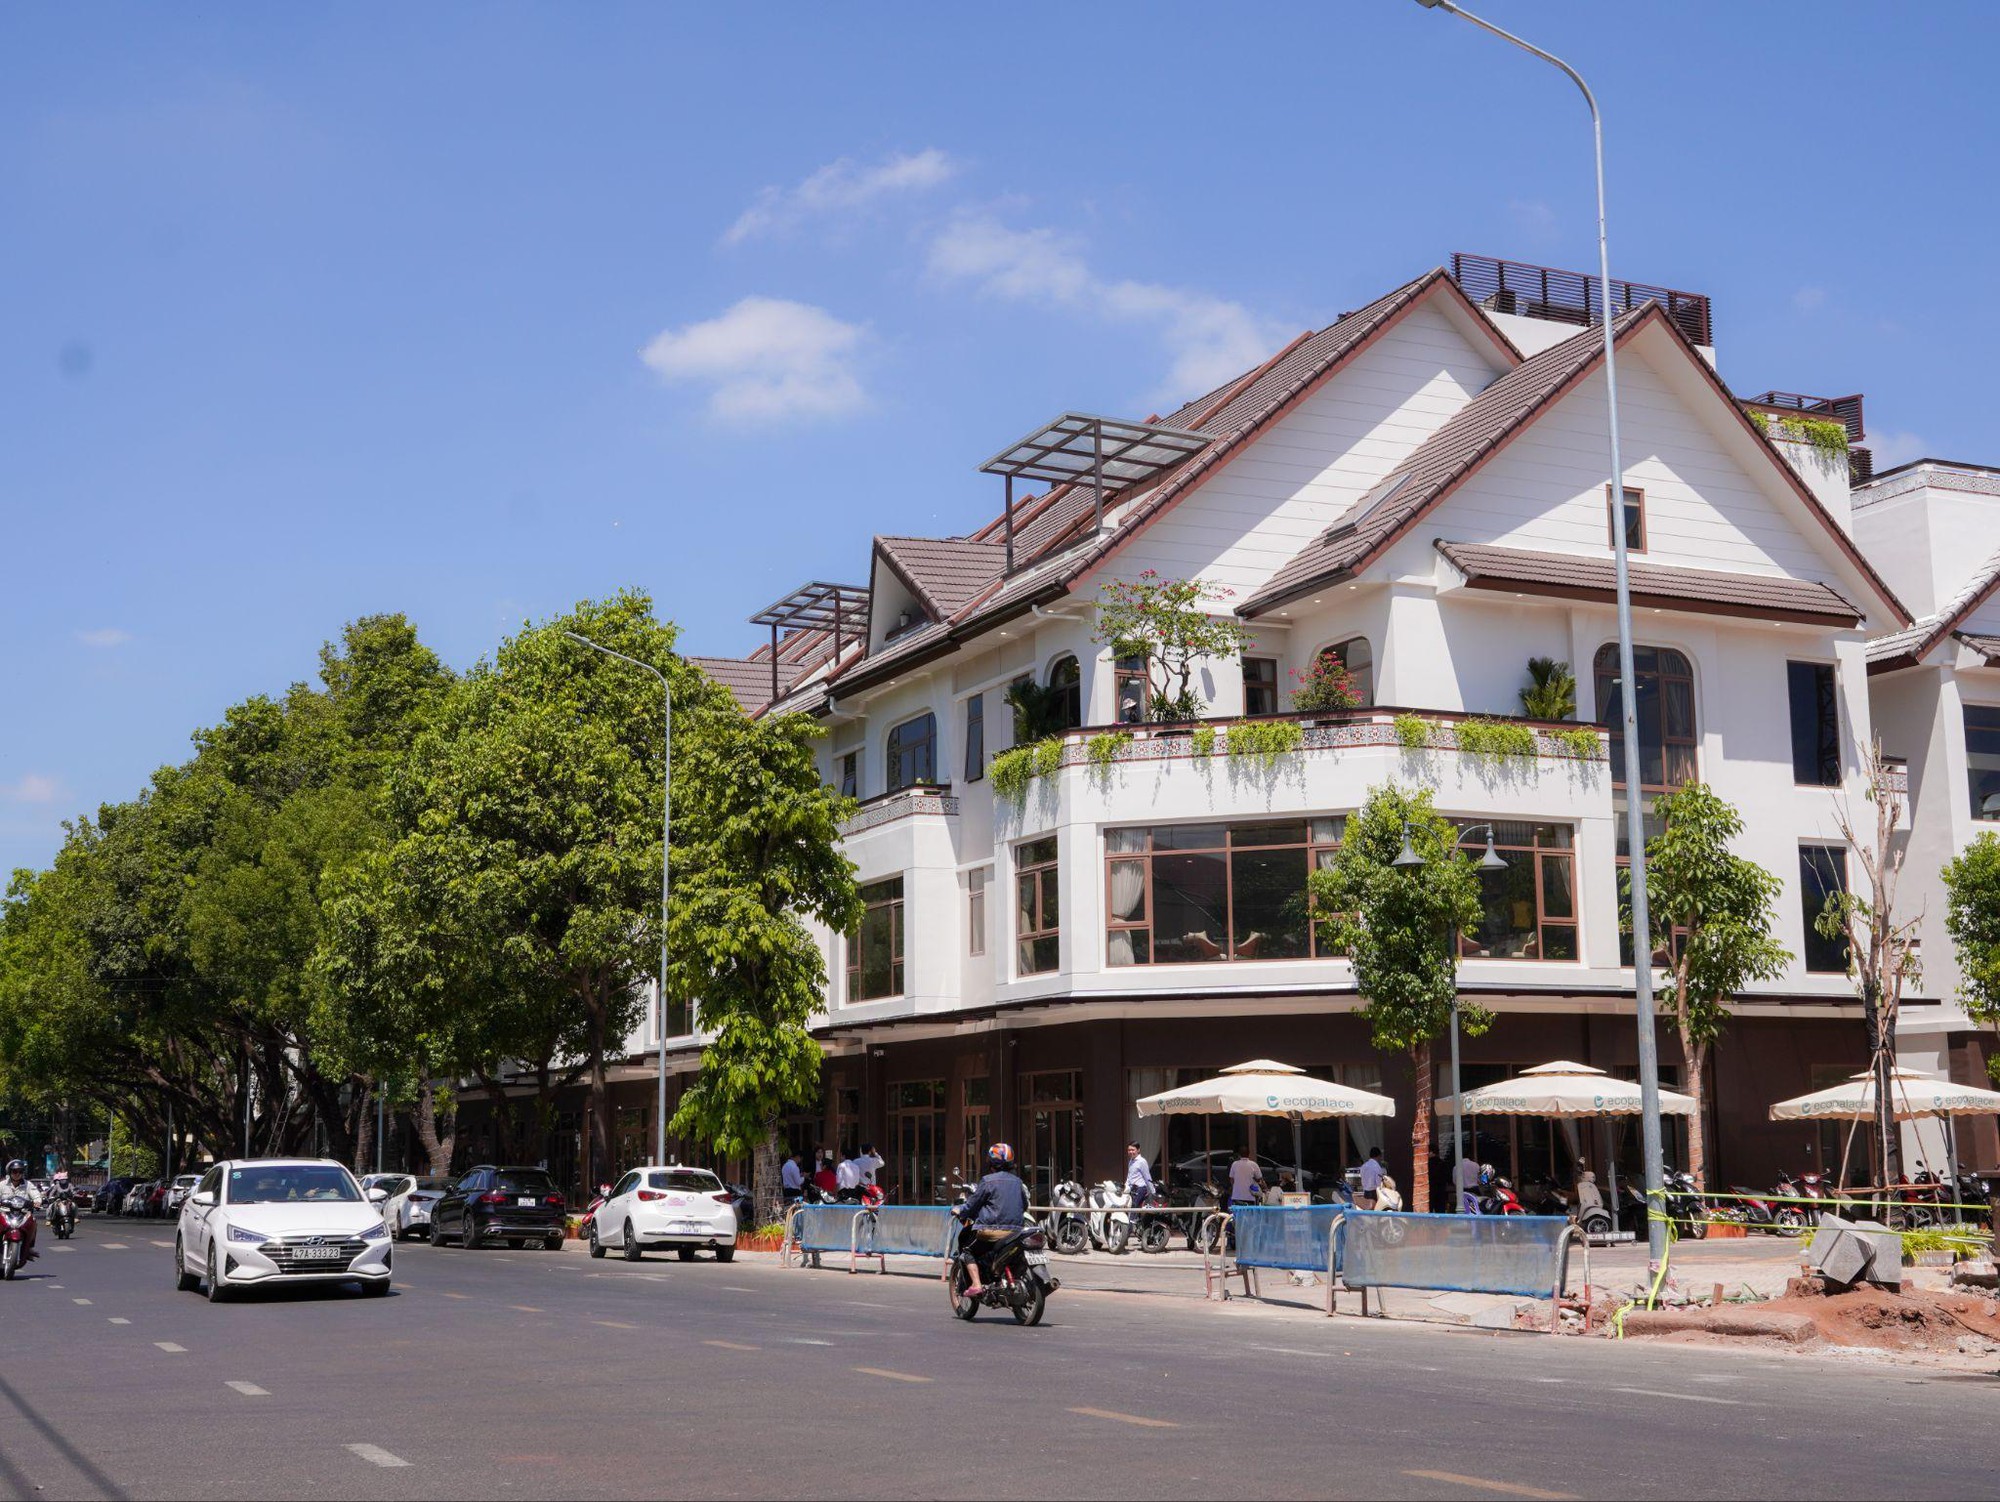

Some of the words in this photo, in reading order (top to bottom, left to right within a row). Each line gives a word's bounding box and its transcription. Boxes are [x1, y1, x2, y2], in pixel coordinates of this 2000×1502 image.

[1283, 1097, 1355, 1109] ecopalace
[1475, 1097, 1527, 1109] ecopalace
[1608, 1096, 1664, 1109] ecopae
